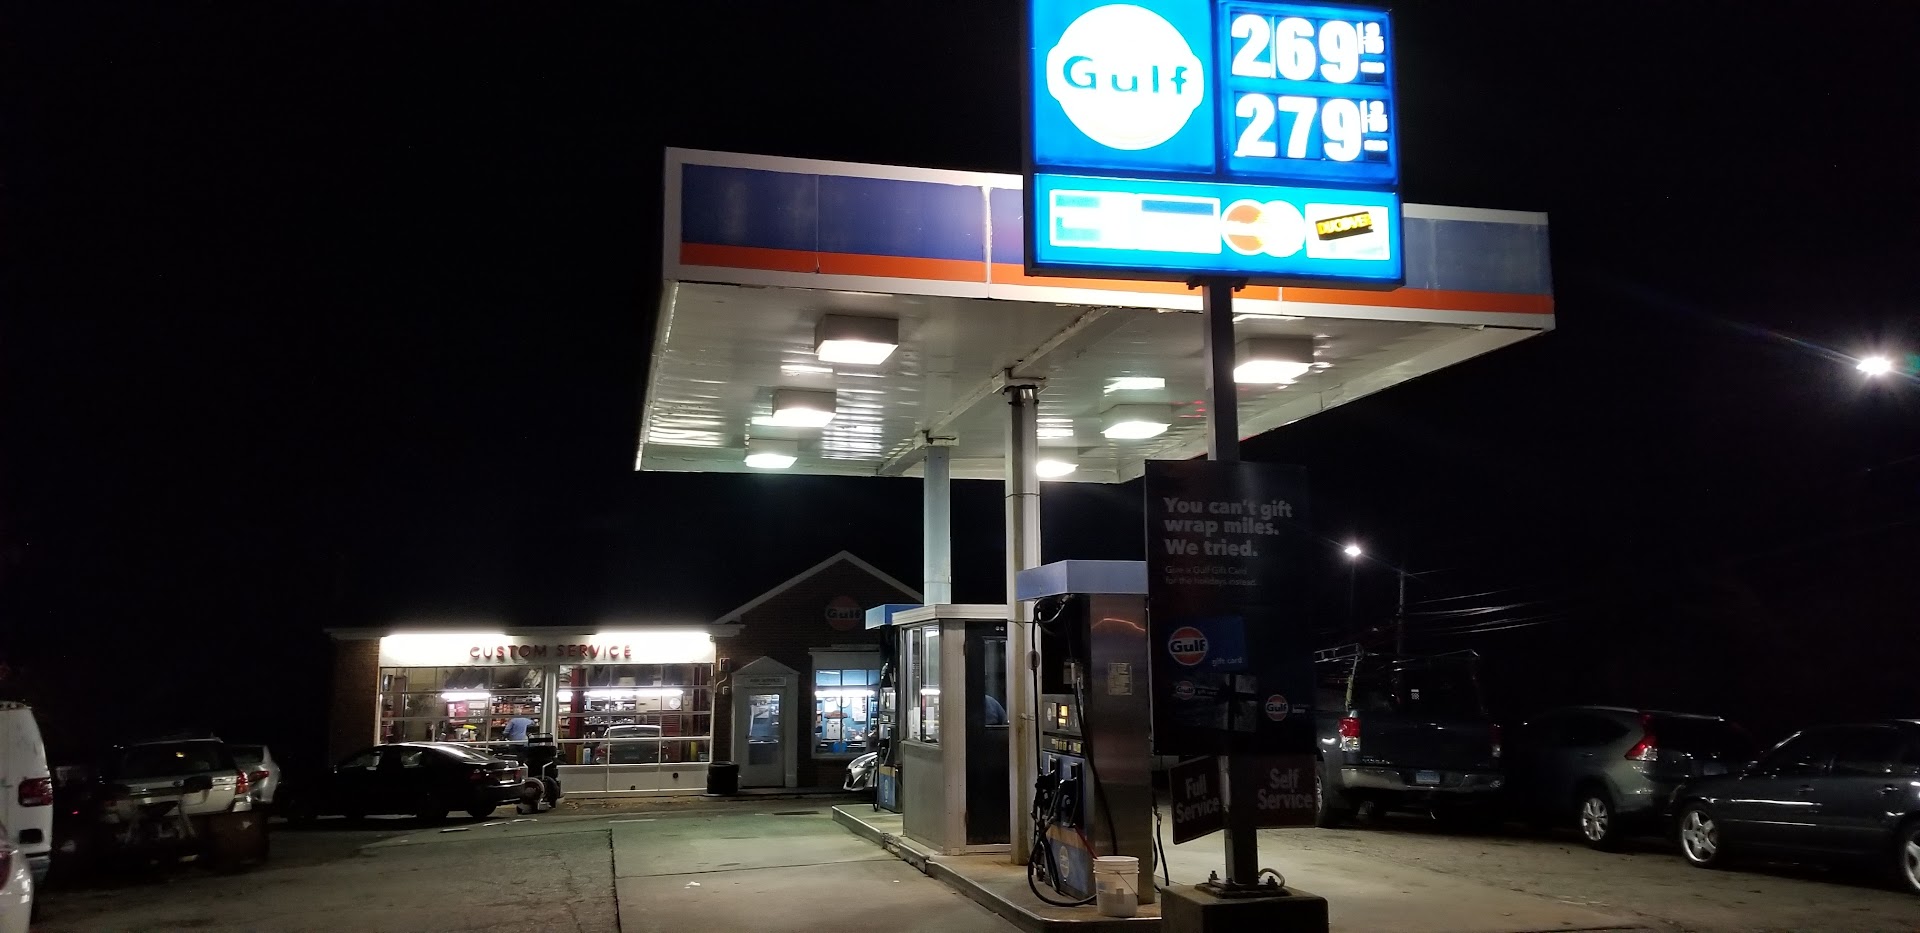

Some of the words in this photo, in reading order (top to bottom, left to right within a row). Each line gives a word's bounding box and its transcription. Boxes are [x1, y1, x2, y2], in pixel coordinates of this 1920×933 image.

[1231, 14, 1359, 84] 269
[1062, 55, 1188, 95] Gulf
[1234, 93, 1362, 162] 279
[1163, 497, 1203, 513] You
[1208, 500, 1256, 516] can't
[1260, 500, 1293, 520] gift
[1164, 519, 1218, 537] wrap
[1223, 516, 1280, 535] miles.
[1164, 538, 1199, 555] We
[1203, 538, 1258, 557] tried.
[828, 608, 860, 618] Gulf
[470, 645, 547, 659] CUSTOM
[556, 644, 632, 658] SERVICE
[1170, 640, 1206, 652] Gulf
[1267, 703, 1287, 712] Gulf
[1185, 773, 1208, 799] Full
[1269, 767, 1299, 789] Self
[1175, 796, 1220, 824] Service
[1257, 788, 1313, 810] Service
